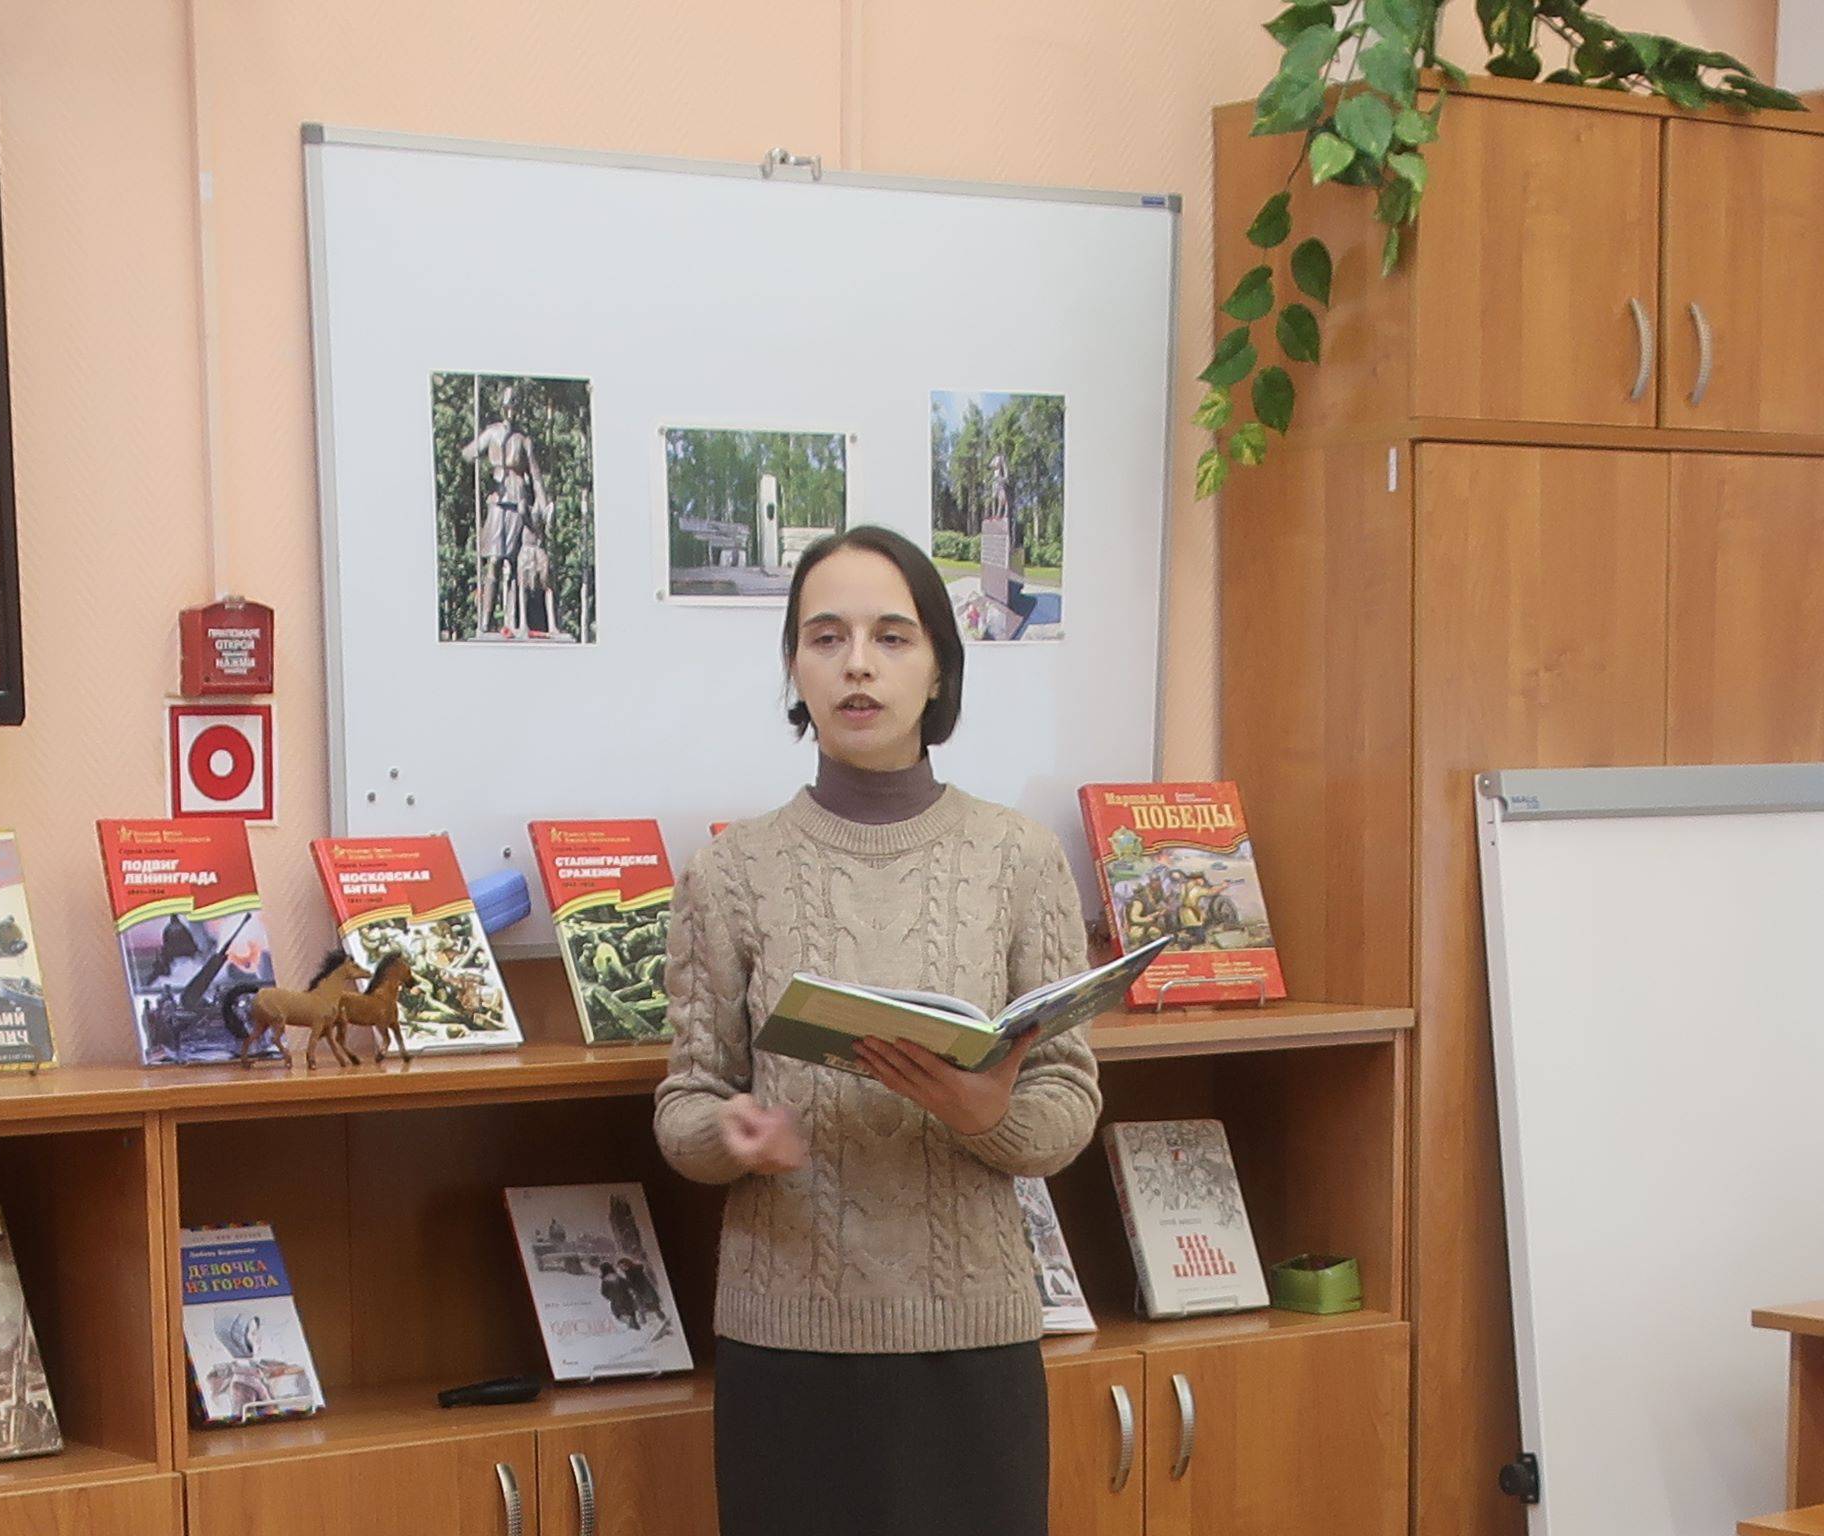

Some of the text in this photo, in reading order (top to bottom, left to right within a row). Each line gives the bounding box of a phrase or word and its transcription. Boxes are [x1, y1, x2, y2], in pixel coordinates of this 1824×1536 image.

[1130, 803, 1237, 834] ПОБЕДЫ
[121, 858, 180, 874] ПОДВИГ
[123, 871, 219, 886] ЛЕНИНГРАДА
[188, 1260, 267, 1280] ДЕВОЧКА
[212, 1274, 280, 1292] ГОРОДА
